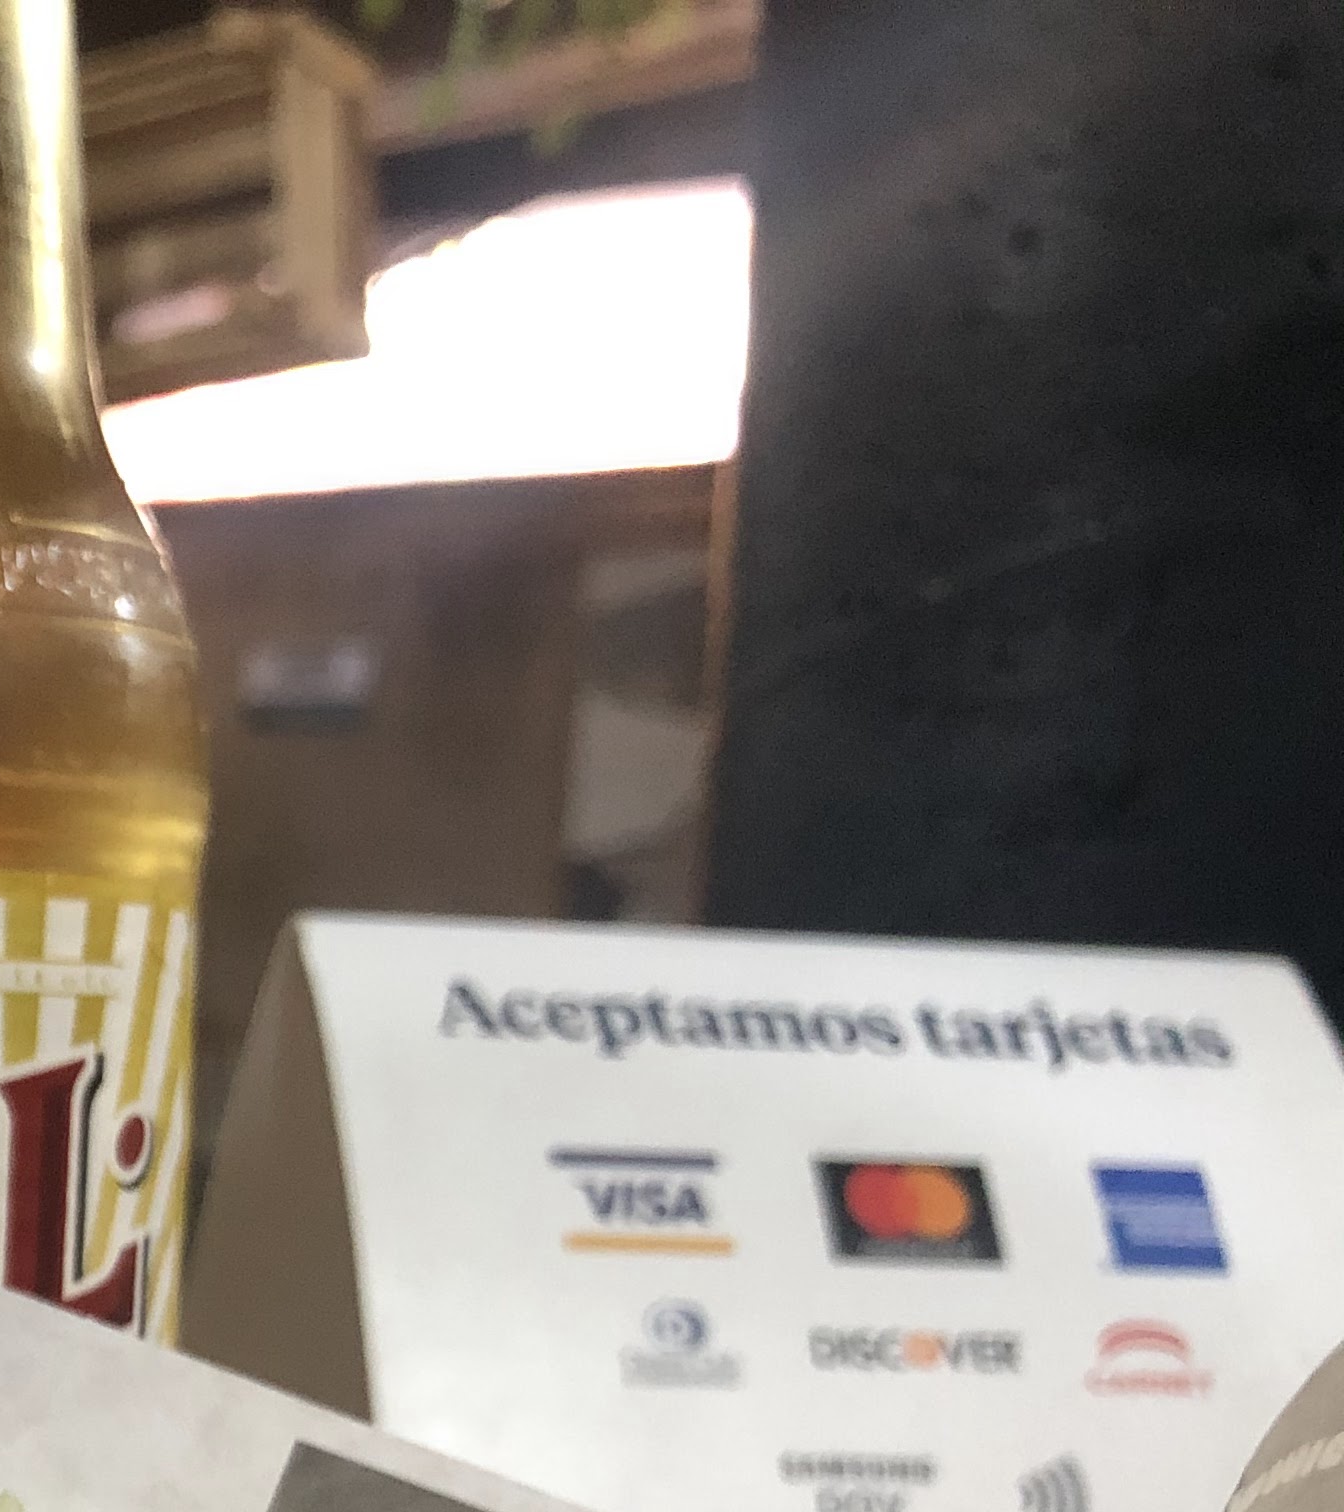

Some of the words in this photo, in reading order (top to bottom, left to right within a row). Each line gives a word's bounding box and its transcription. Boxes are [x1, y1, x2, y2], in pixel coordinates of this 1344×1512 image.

[436, 975, 908, 1062] Aceptamos
[914, 994, 1238, 1074] tarjetas
[576, 1180, 714, 1226] VISA
[808, 1326, 1023, 1376] DISCOVER
